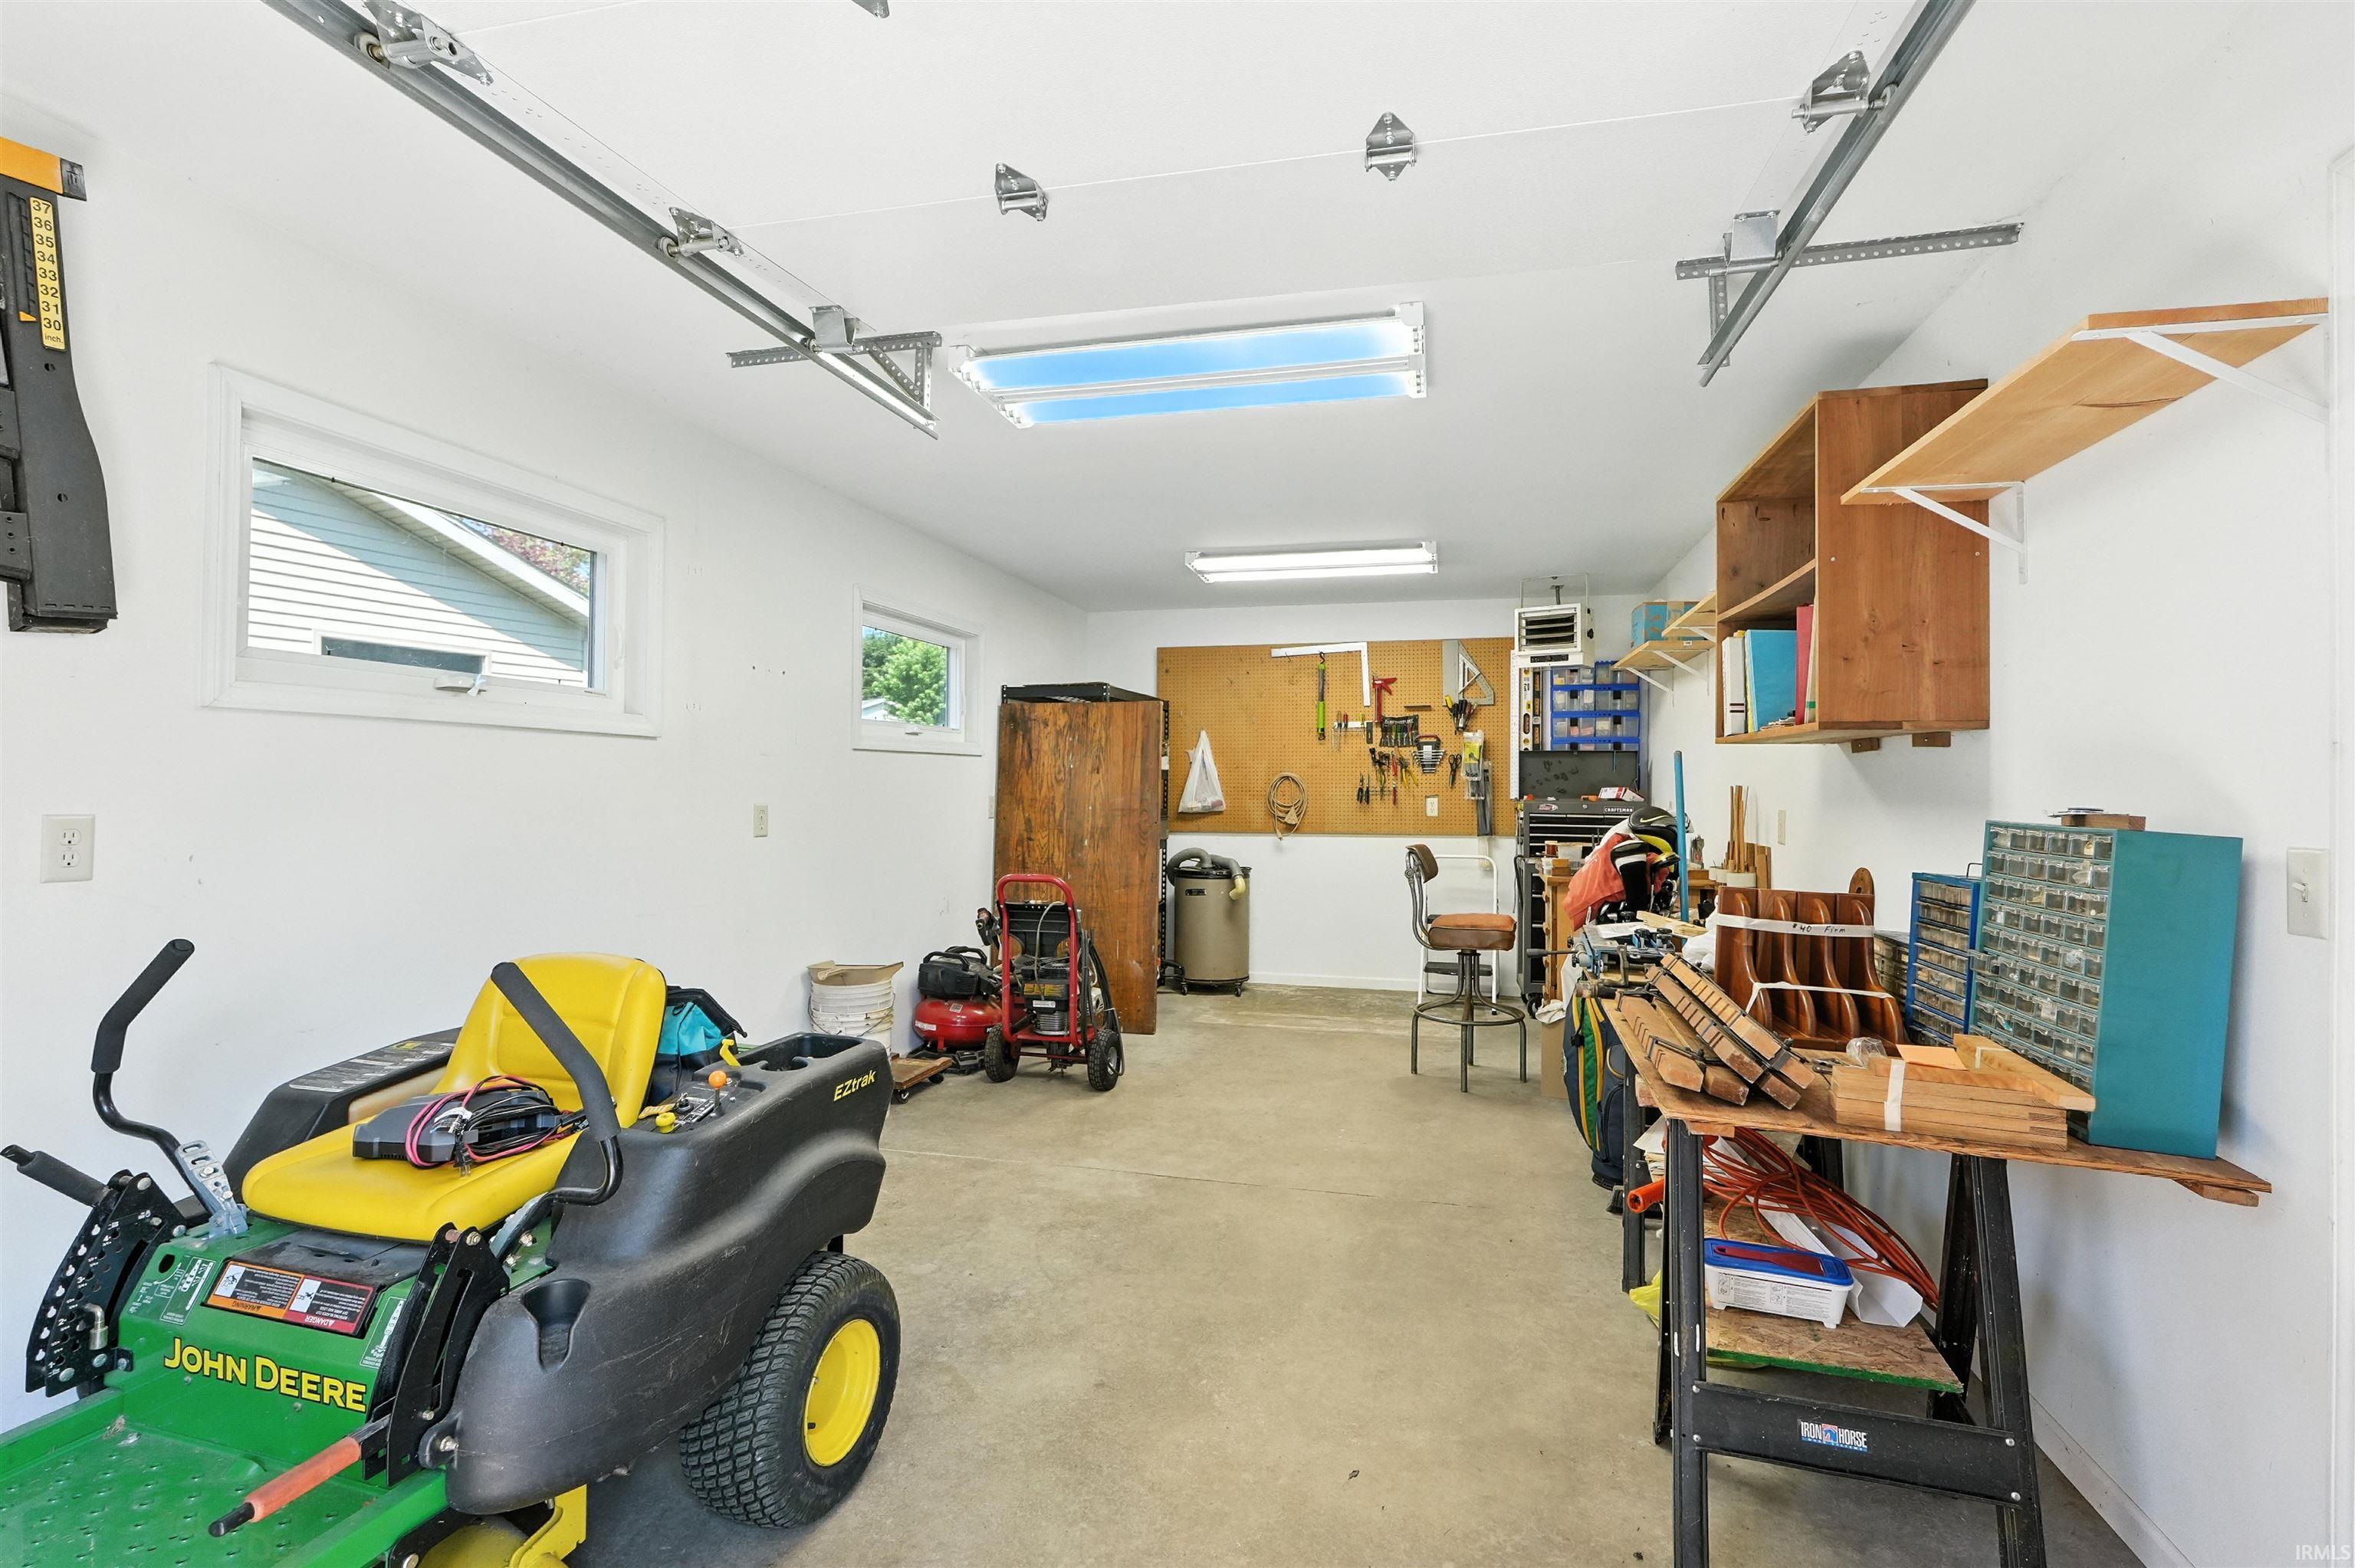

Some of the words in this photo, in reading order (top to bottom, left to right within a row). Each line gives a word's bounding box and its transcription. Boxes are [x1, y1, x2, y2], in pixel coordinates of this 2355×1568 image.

[32, 200, 51, 214] 37
[34, 217, 53, 231] 36
[35, 234, 54, 248] 35
[37, 251, 55, 264] 34
[38, 267, 57, 281] 33
[40, 284, 58, 298] 32
[41, 300, 59, 315] 31
[43, 317, 61, 331] 30
[44, 334, 64, 344] inch.
[833, 1069, 877, 1102] EZtrak
[232, 1301, 258, 1310] WARNING
[304, 1314, 330, 1327] DANGER
[163, 1337, 248, 1386] JOHN
[255, 1354, 367, 1413] DEERE
[1801, 1421, 1823, 1440] IRON
[1838, 1428, 1868, 1448] HORSE
